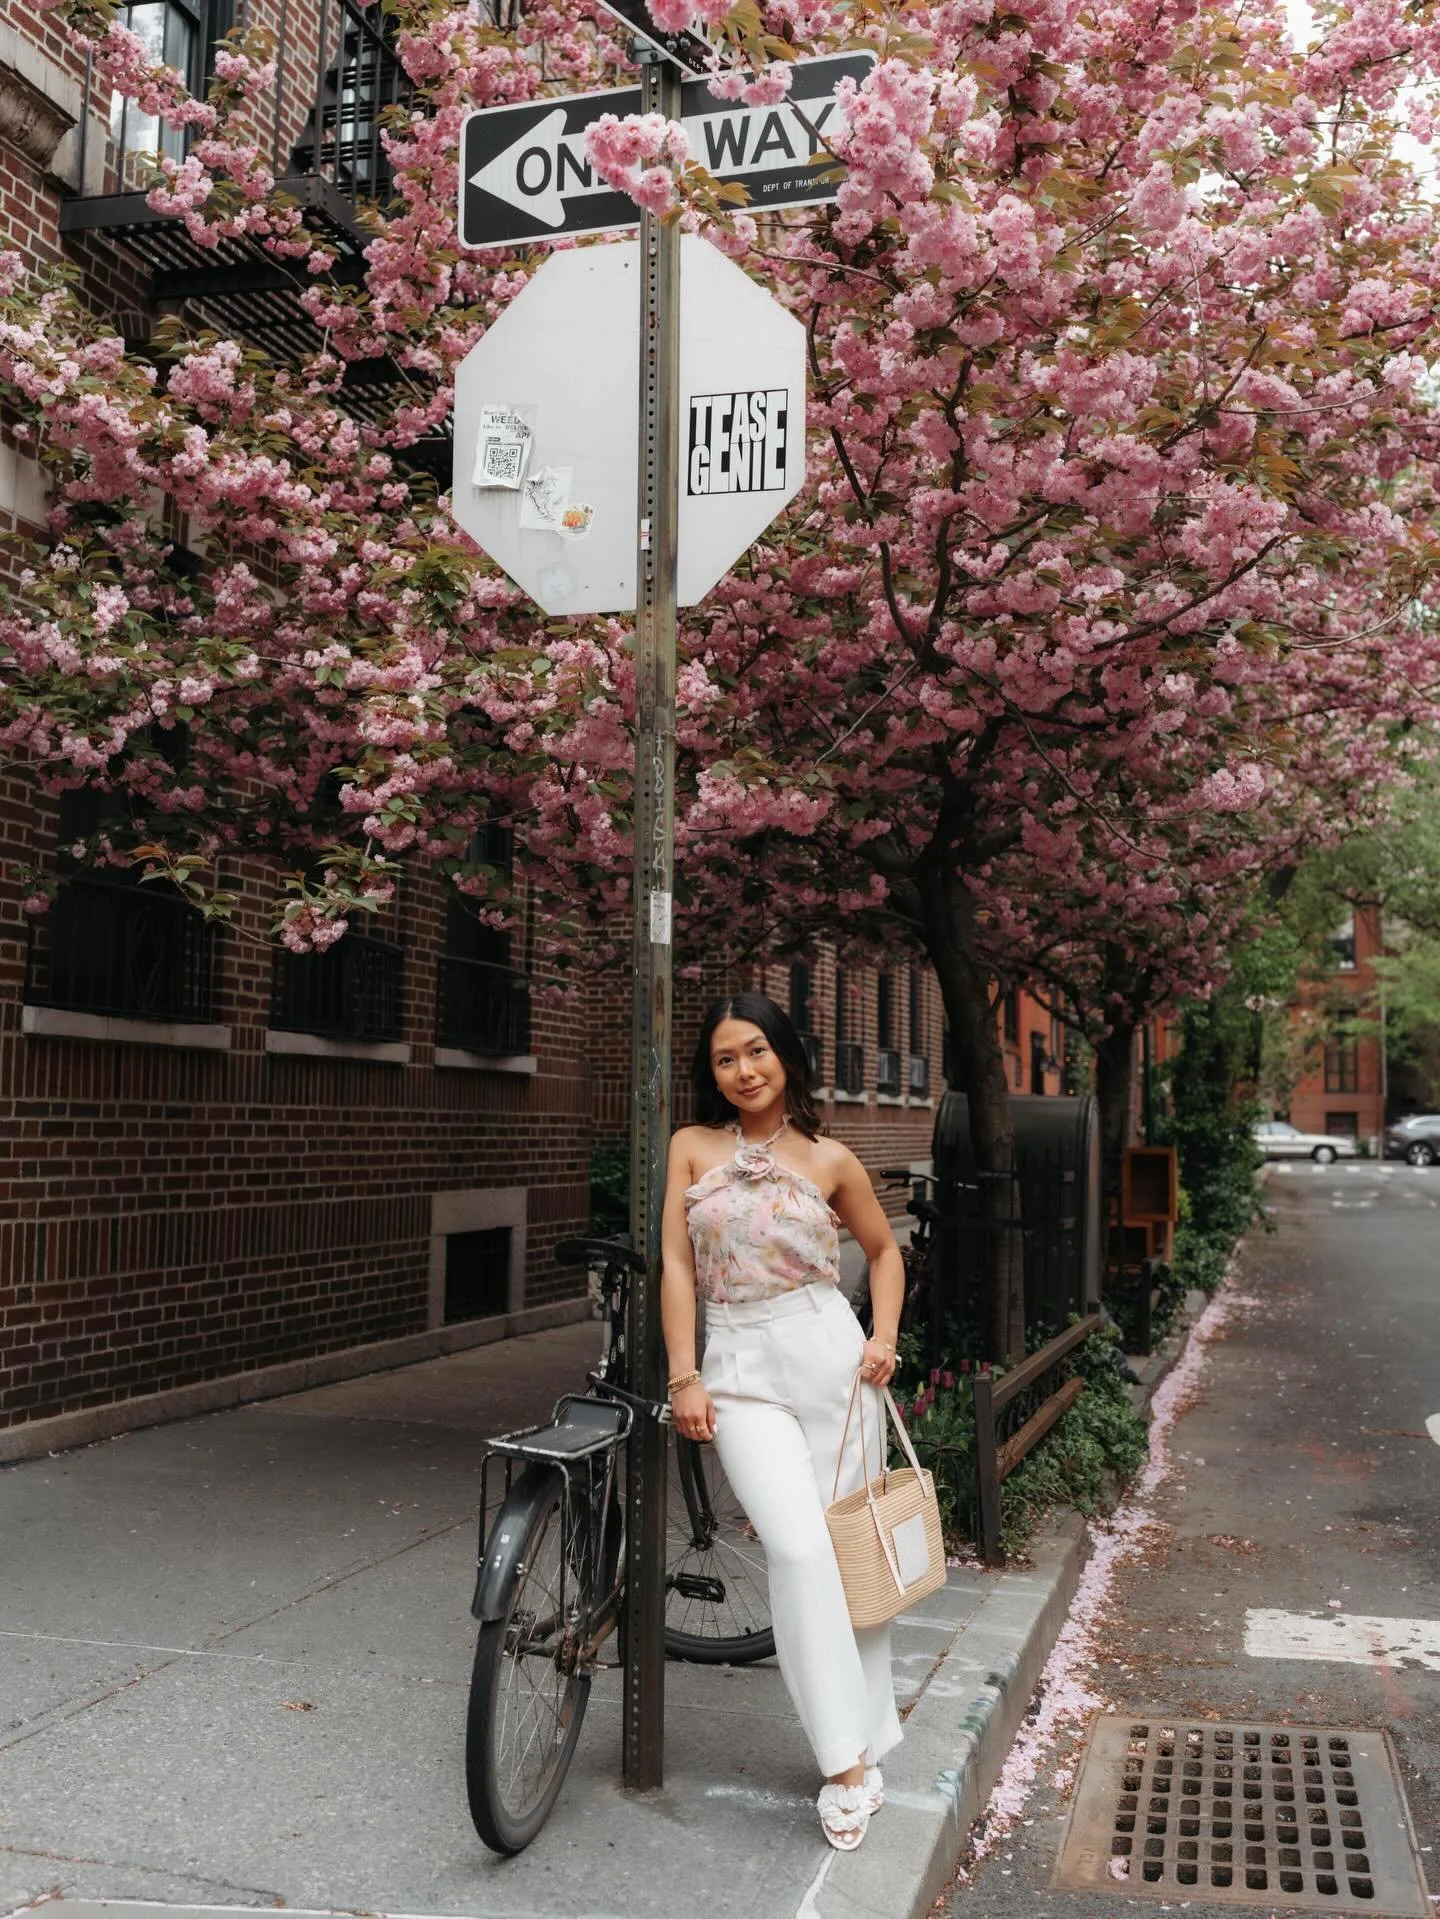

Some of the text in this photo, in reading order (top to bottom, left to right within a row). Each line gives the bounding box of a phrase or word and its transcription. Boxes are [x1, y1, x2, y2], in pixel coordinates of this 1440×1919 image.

[516, 102, 837, 197] ON WAY
[762, 183, 780, 193] DEPT
[783, 180, 793, 190] OF
